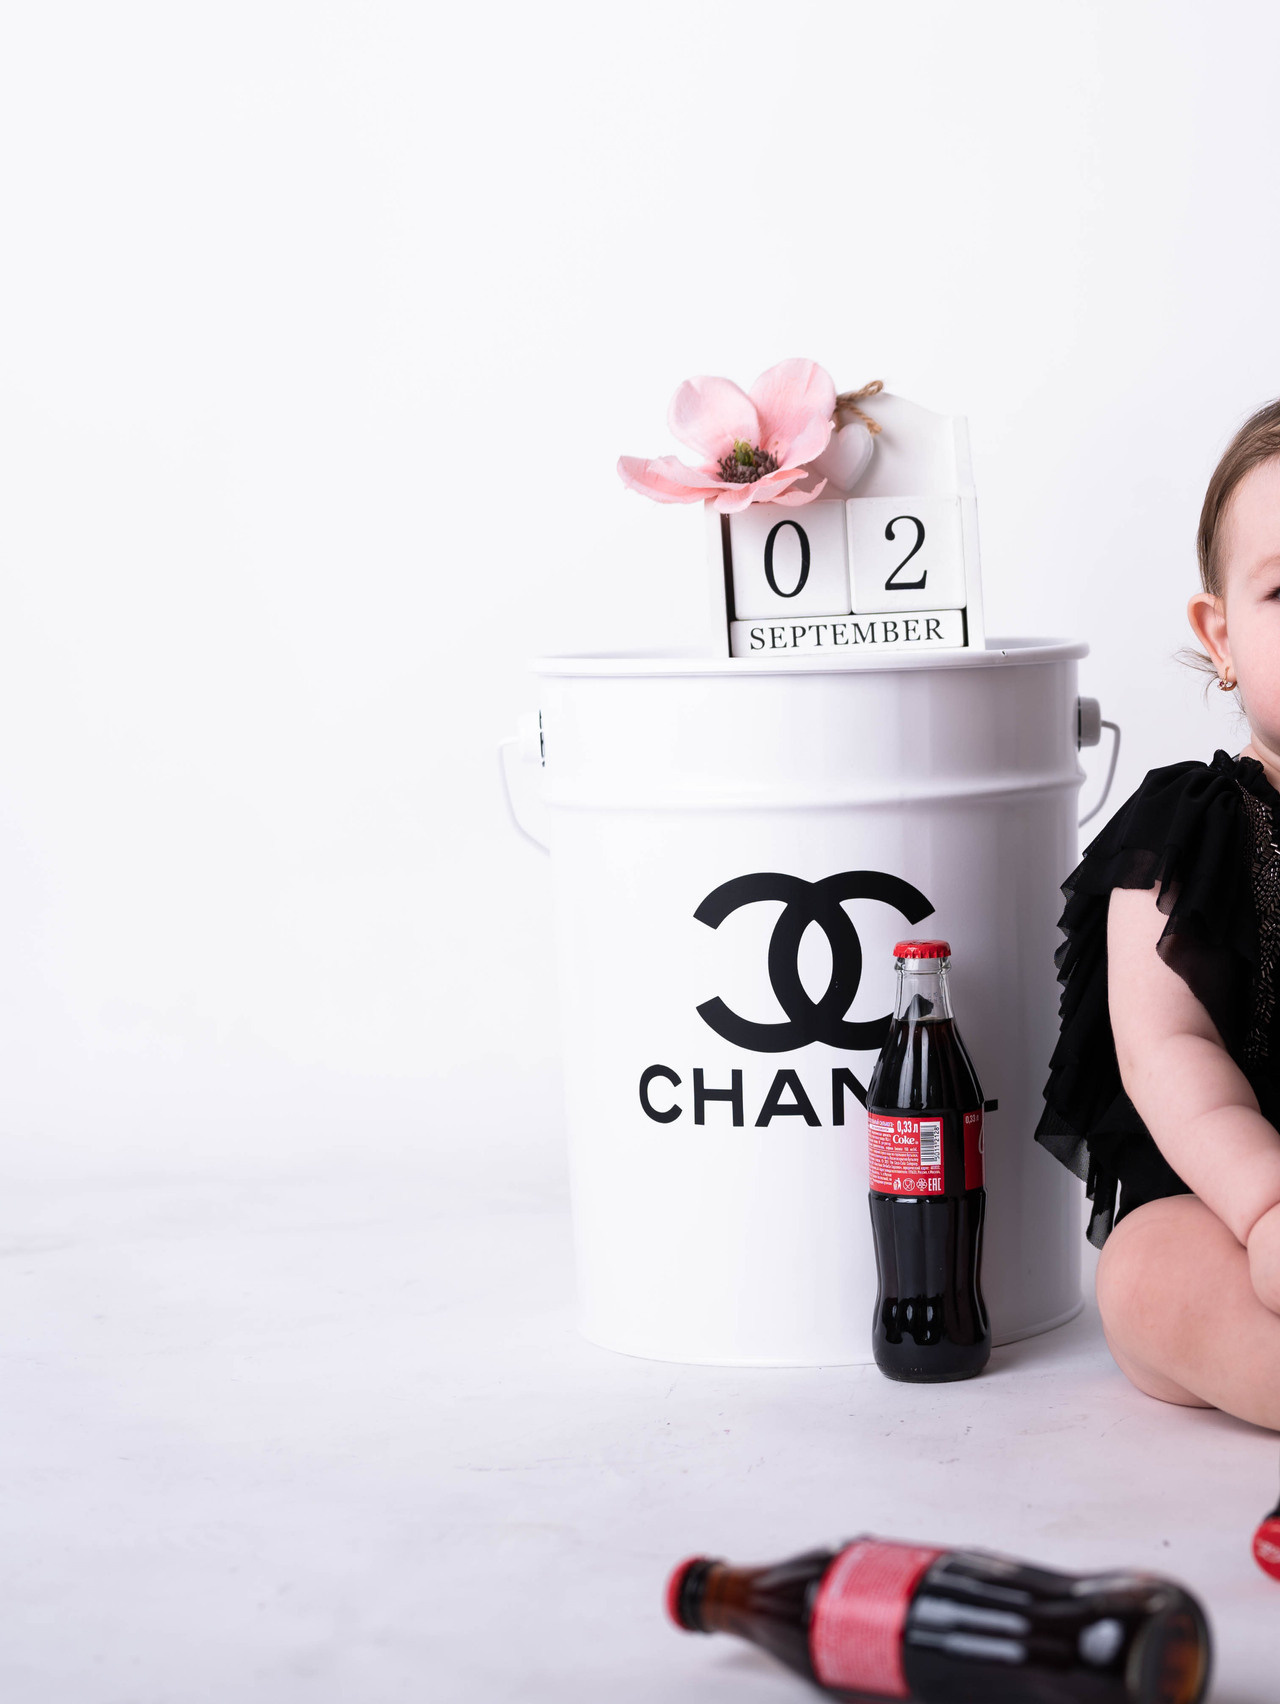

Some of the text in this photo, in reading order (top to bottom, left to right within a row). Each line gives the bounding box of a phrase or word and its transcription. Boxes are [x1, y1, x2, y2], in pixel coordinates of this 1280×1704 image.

[750, 617, 944, 650] SEPTEMBER
[639, 1063, 998, 1127] CHAN
[896, 1120, 912, 1135] 0,33
[912, 1123, 919, 1133] л
[892, 1134, 915, 1145] Coke
[928, 1177, 942, 1192] EAC
